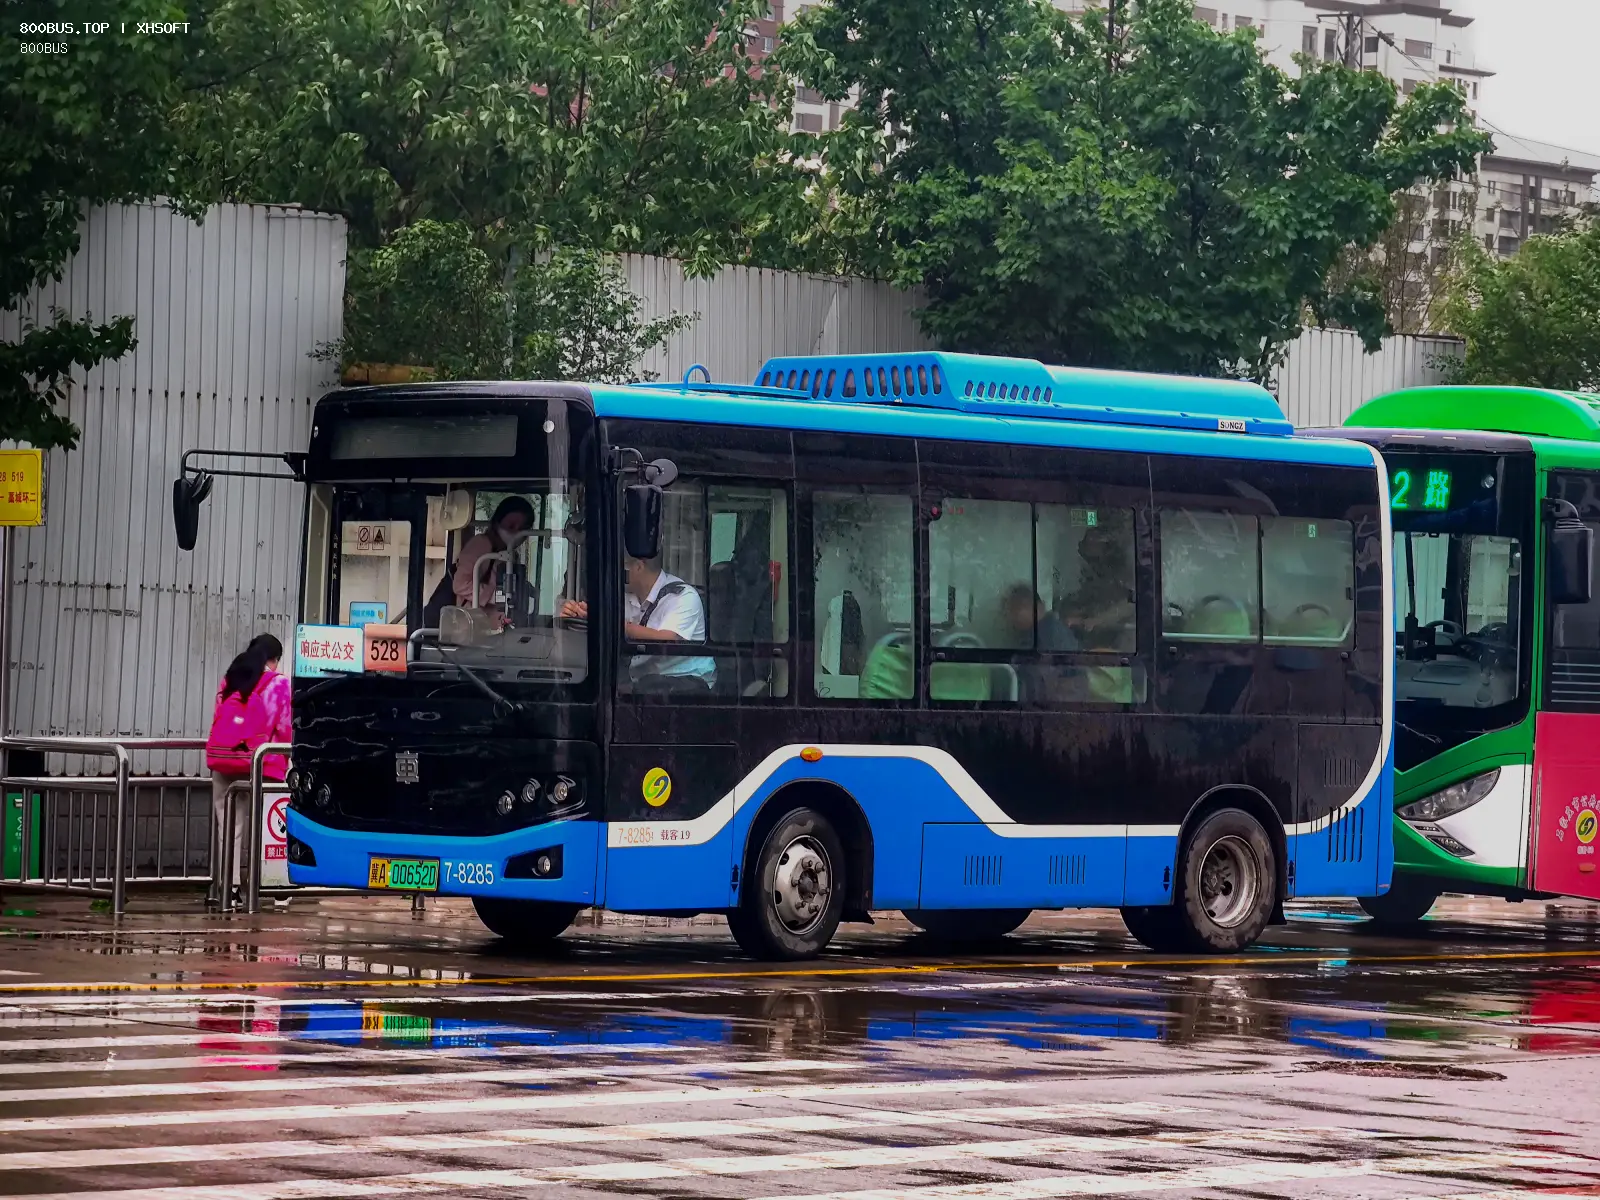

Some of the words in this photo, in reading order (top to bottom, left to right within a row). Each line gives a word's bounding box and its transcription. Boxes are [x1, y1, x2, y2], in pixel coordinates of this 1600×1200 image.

[1220, 421, 1244, 430] SONGZ
[11, 471, 24, 482] 519
[300, 640, 355, 661] 响应式公交
[370, 640, 399, 661] 528
[444, 862, 494, 885] 7-8285
